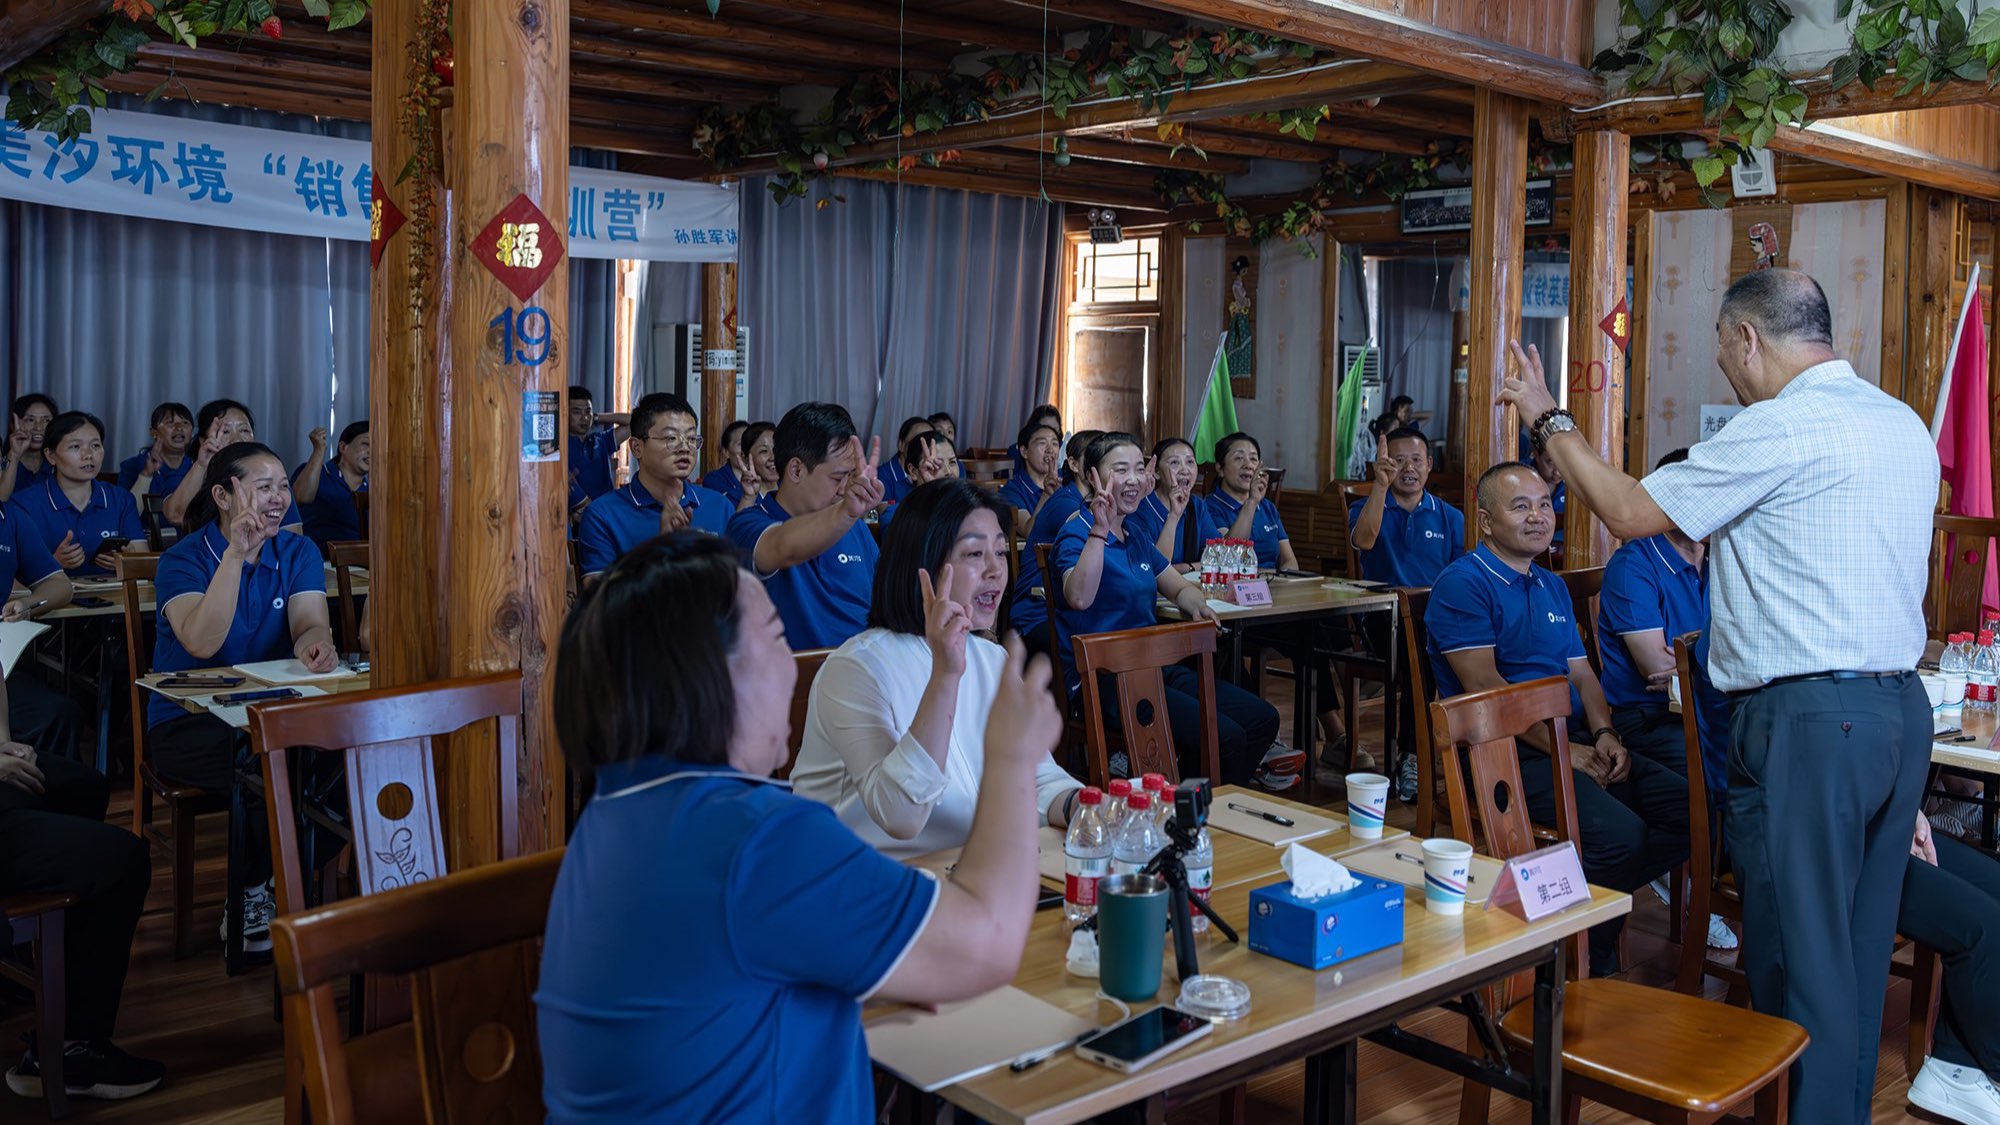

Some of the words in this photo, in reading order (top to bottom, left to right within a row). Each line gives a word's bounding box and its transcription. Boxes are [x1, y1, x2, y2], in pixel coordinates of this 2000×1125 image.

[490, 306, 551, 366] 19
[1569, 361, 1605, 393] 20
[1704, 416, 1734, 432] 光盘
[1537, 877, 1573, 905] 第二组
